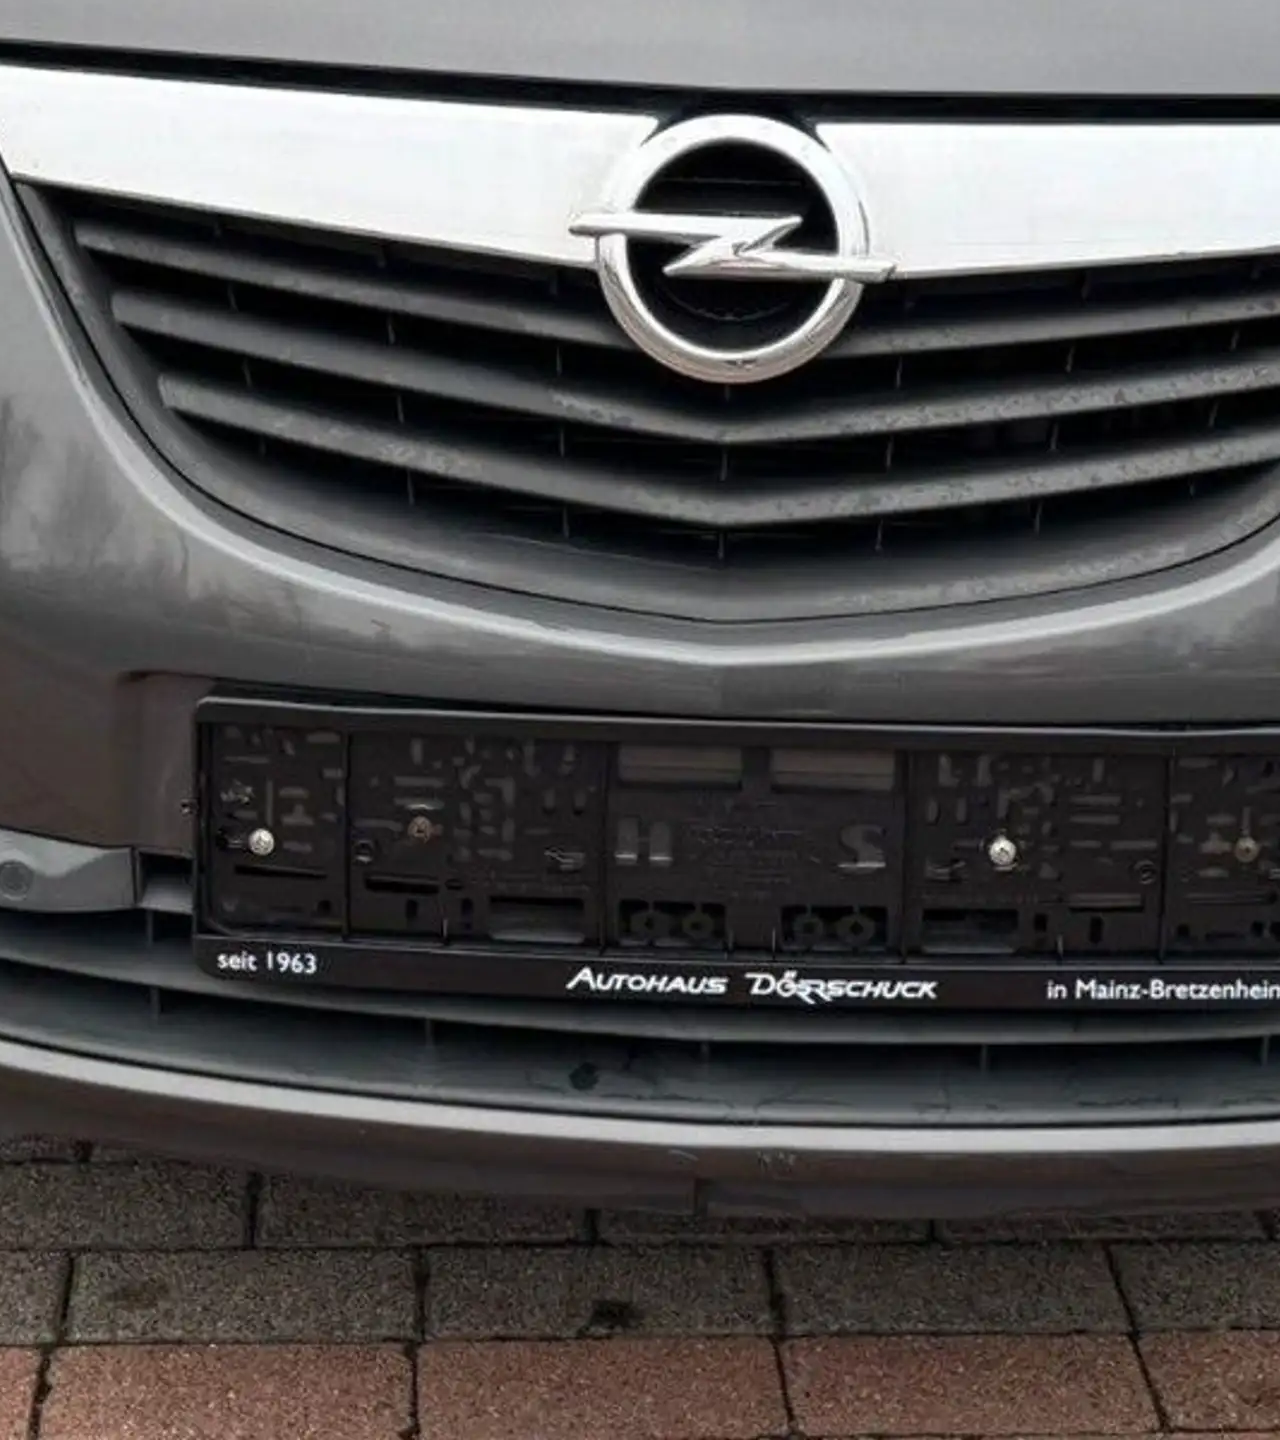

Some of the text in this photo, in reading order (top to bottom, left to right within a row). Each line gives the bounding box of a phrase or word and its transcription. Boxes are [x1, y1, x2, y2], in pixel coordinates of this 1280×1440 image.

[217, 951, 257, 971] seit
[267, 951, 318, 974] 1963
[1047, 979, 1067, 999] in
